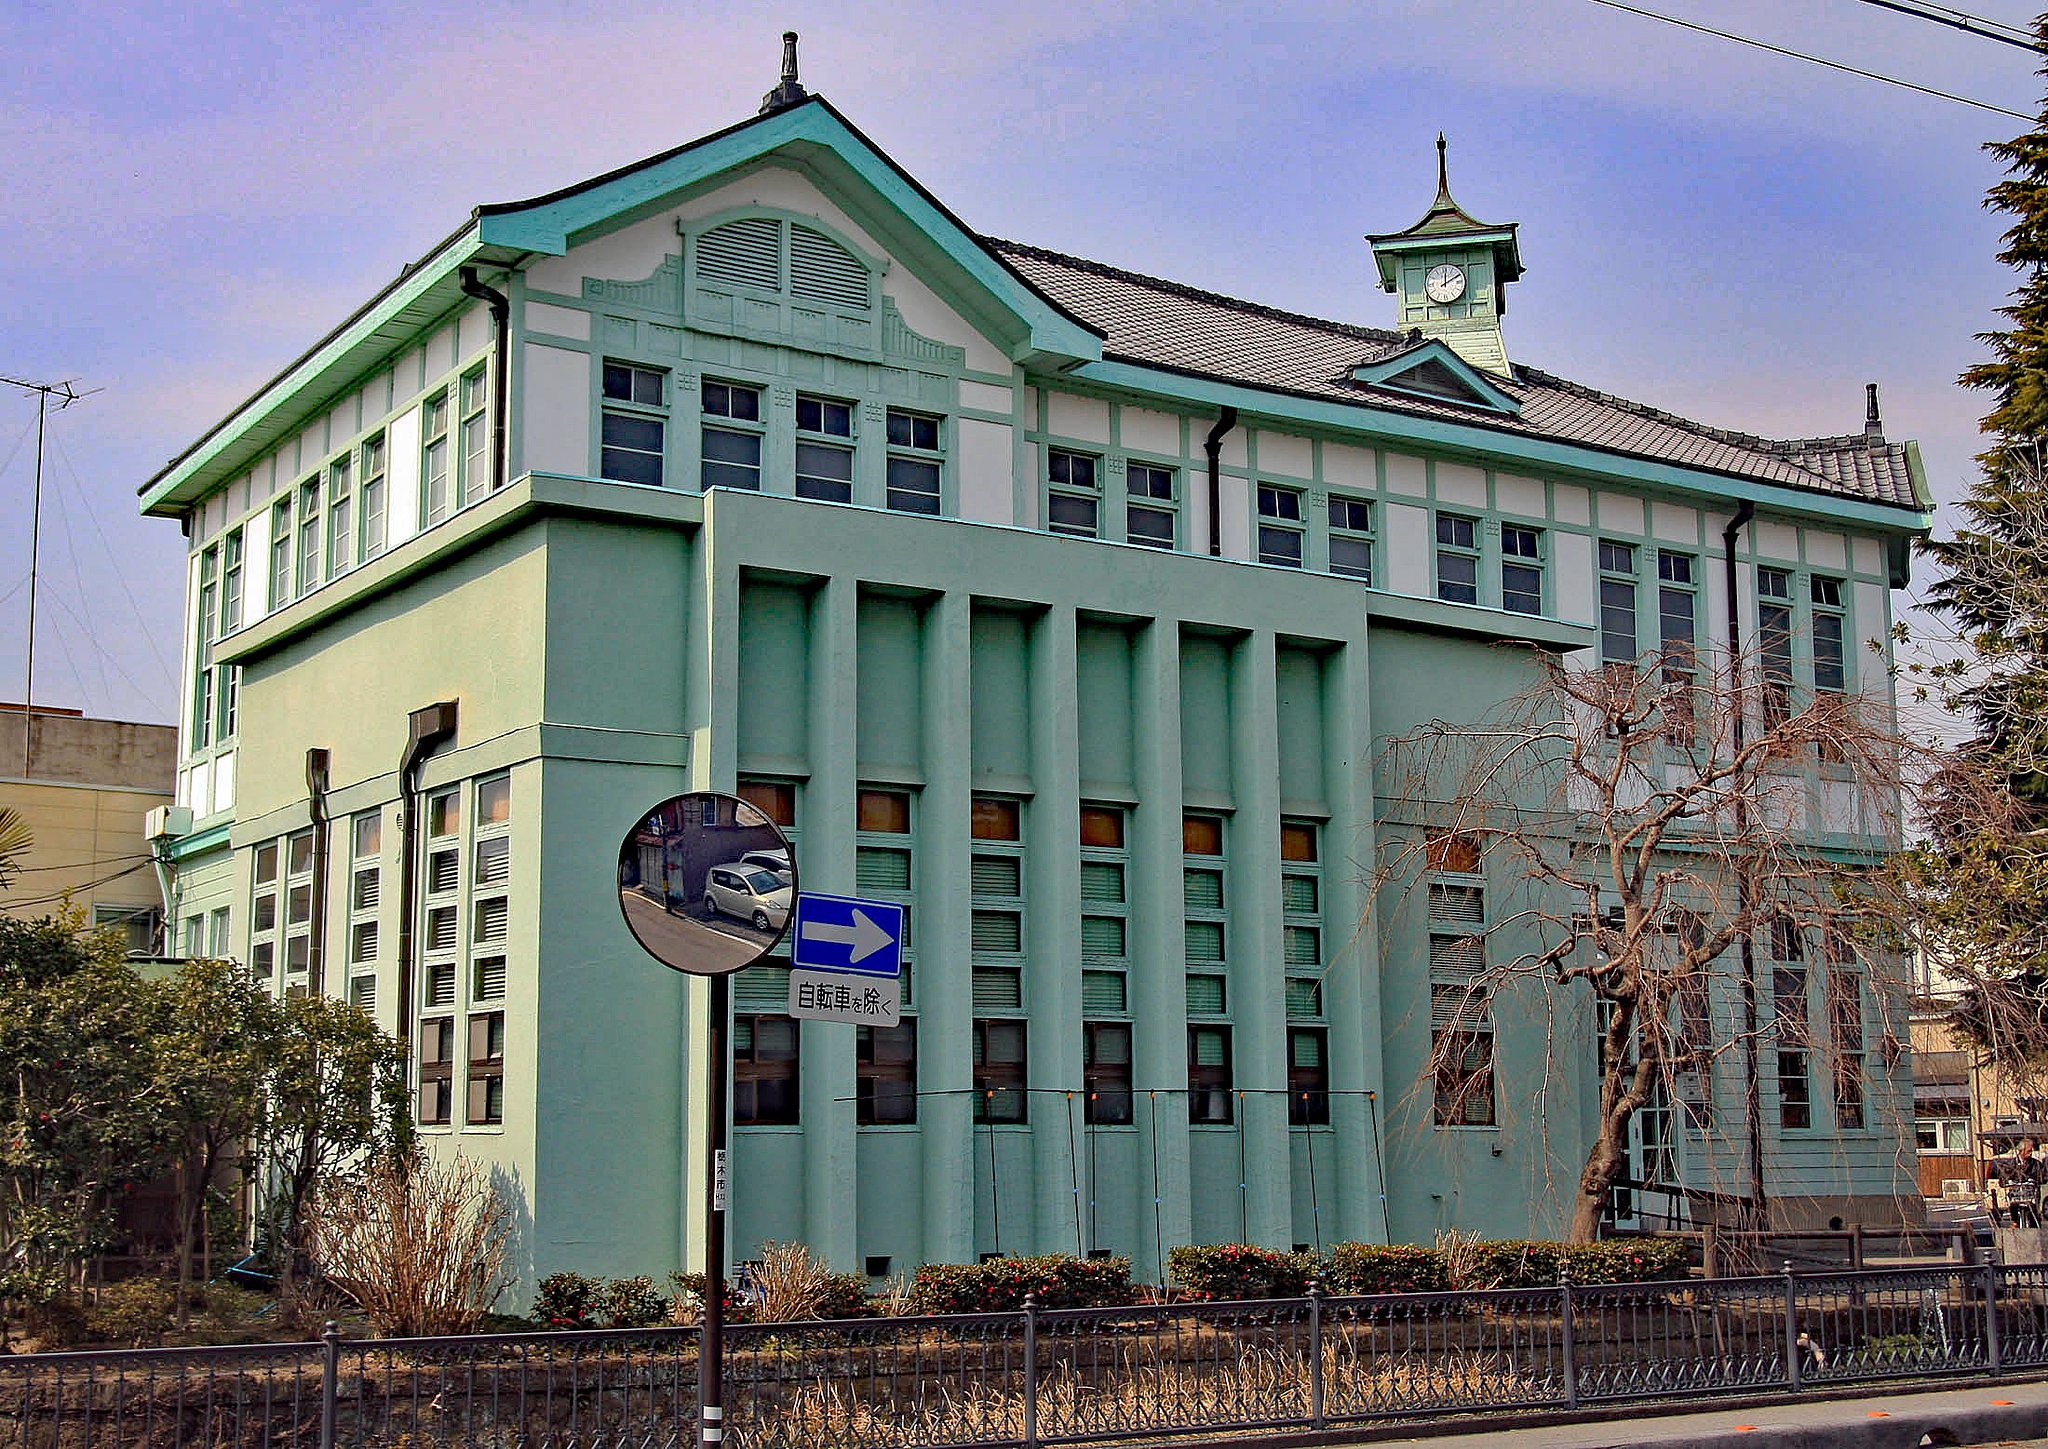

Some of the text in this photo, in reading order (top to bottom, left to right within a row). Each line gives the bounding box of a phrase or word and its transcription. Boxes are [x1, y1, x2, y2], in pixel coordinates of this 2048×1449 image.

[798, 981, 891, 1015] 自転車を除く
